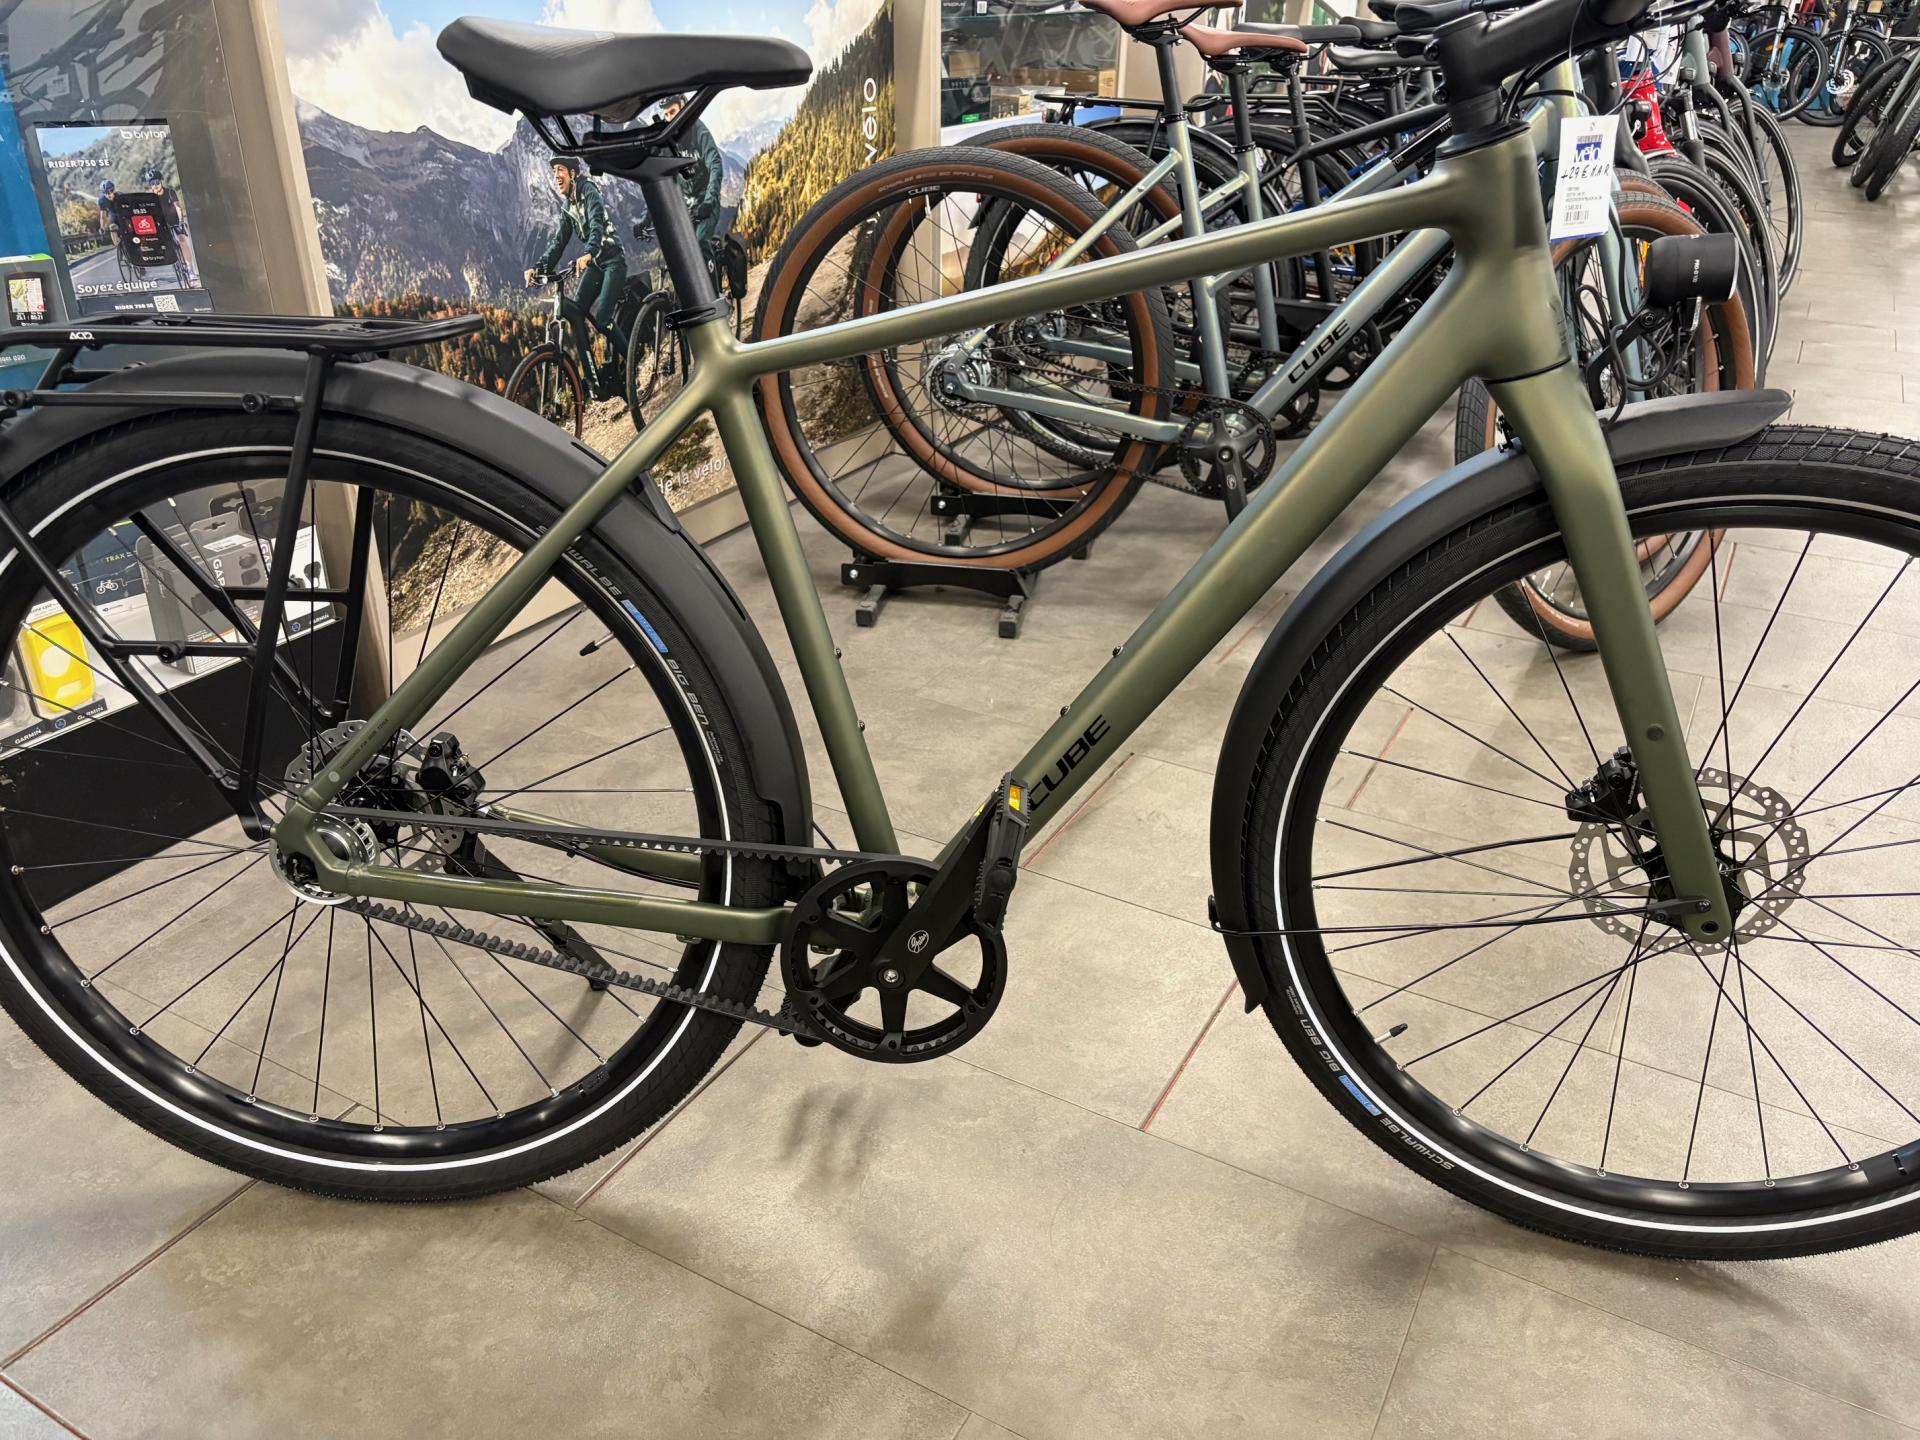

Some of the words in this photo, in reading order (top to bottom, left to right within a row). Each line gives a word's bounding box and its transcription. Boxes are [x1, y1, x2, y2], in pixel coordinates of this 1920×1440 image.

[862, 77, 878, 162] vélo
[133, 129, 167, 140] bryton
[47, 160, 76, 169] RIDER
[78, 159, 96, 168] 750
[98, 159, 111, 167] SE
[77, 284, 114, 295] Soyez
[1288, 319, 1350, 384] CUBE
[666, 659, 689, 686] BIG
[687, 692, 709, 726] BEN
[14, 728, 42, 745] GARMIN
[1028, 714, 1111, 811] CUBE
[1300, 1018, 1322, 1047] BEN
[1319, 1050, 1341, 1073] BIG
[1379, 1117, 1455, 1171] SCHWALBE
